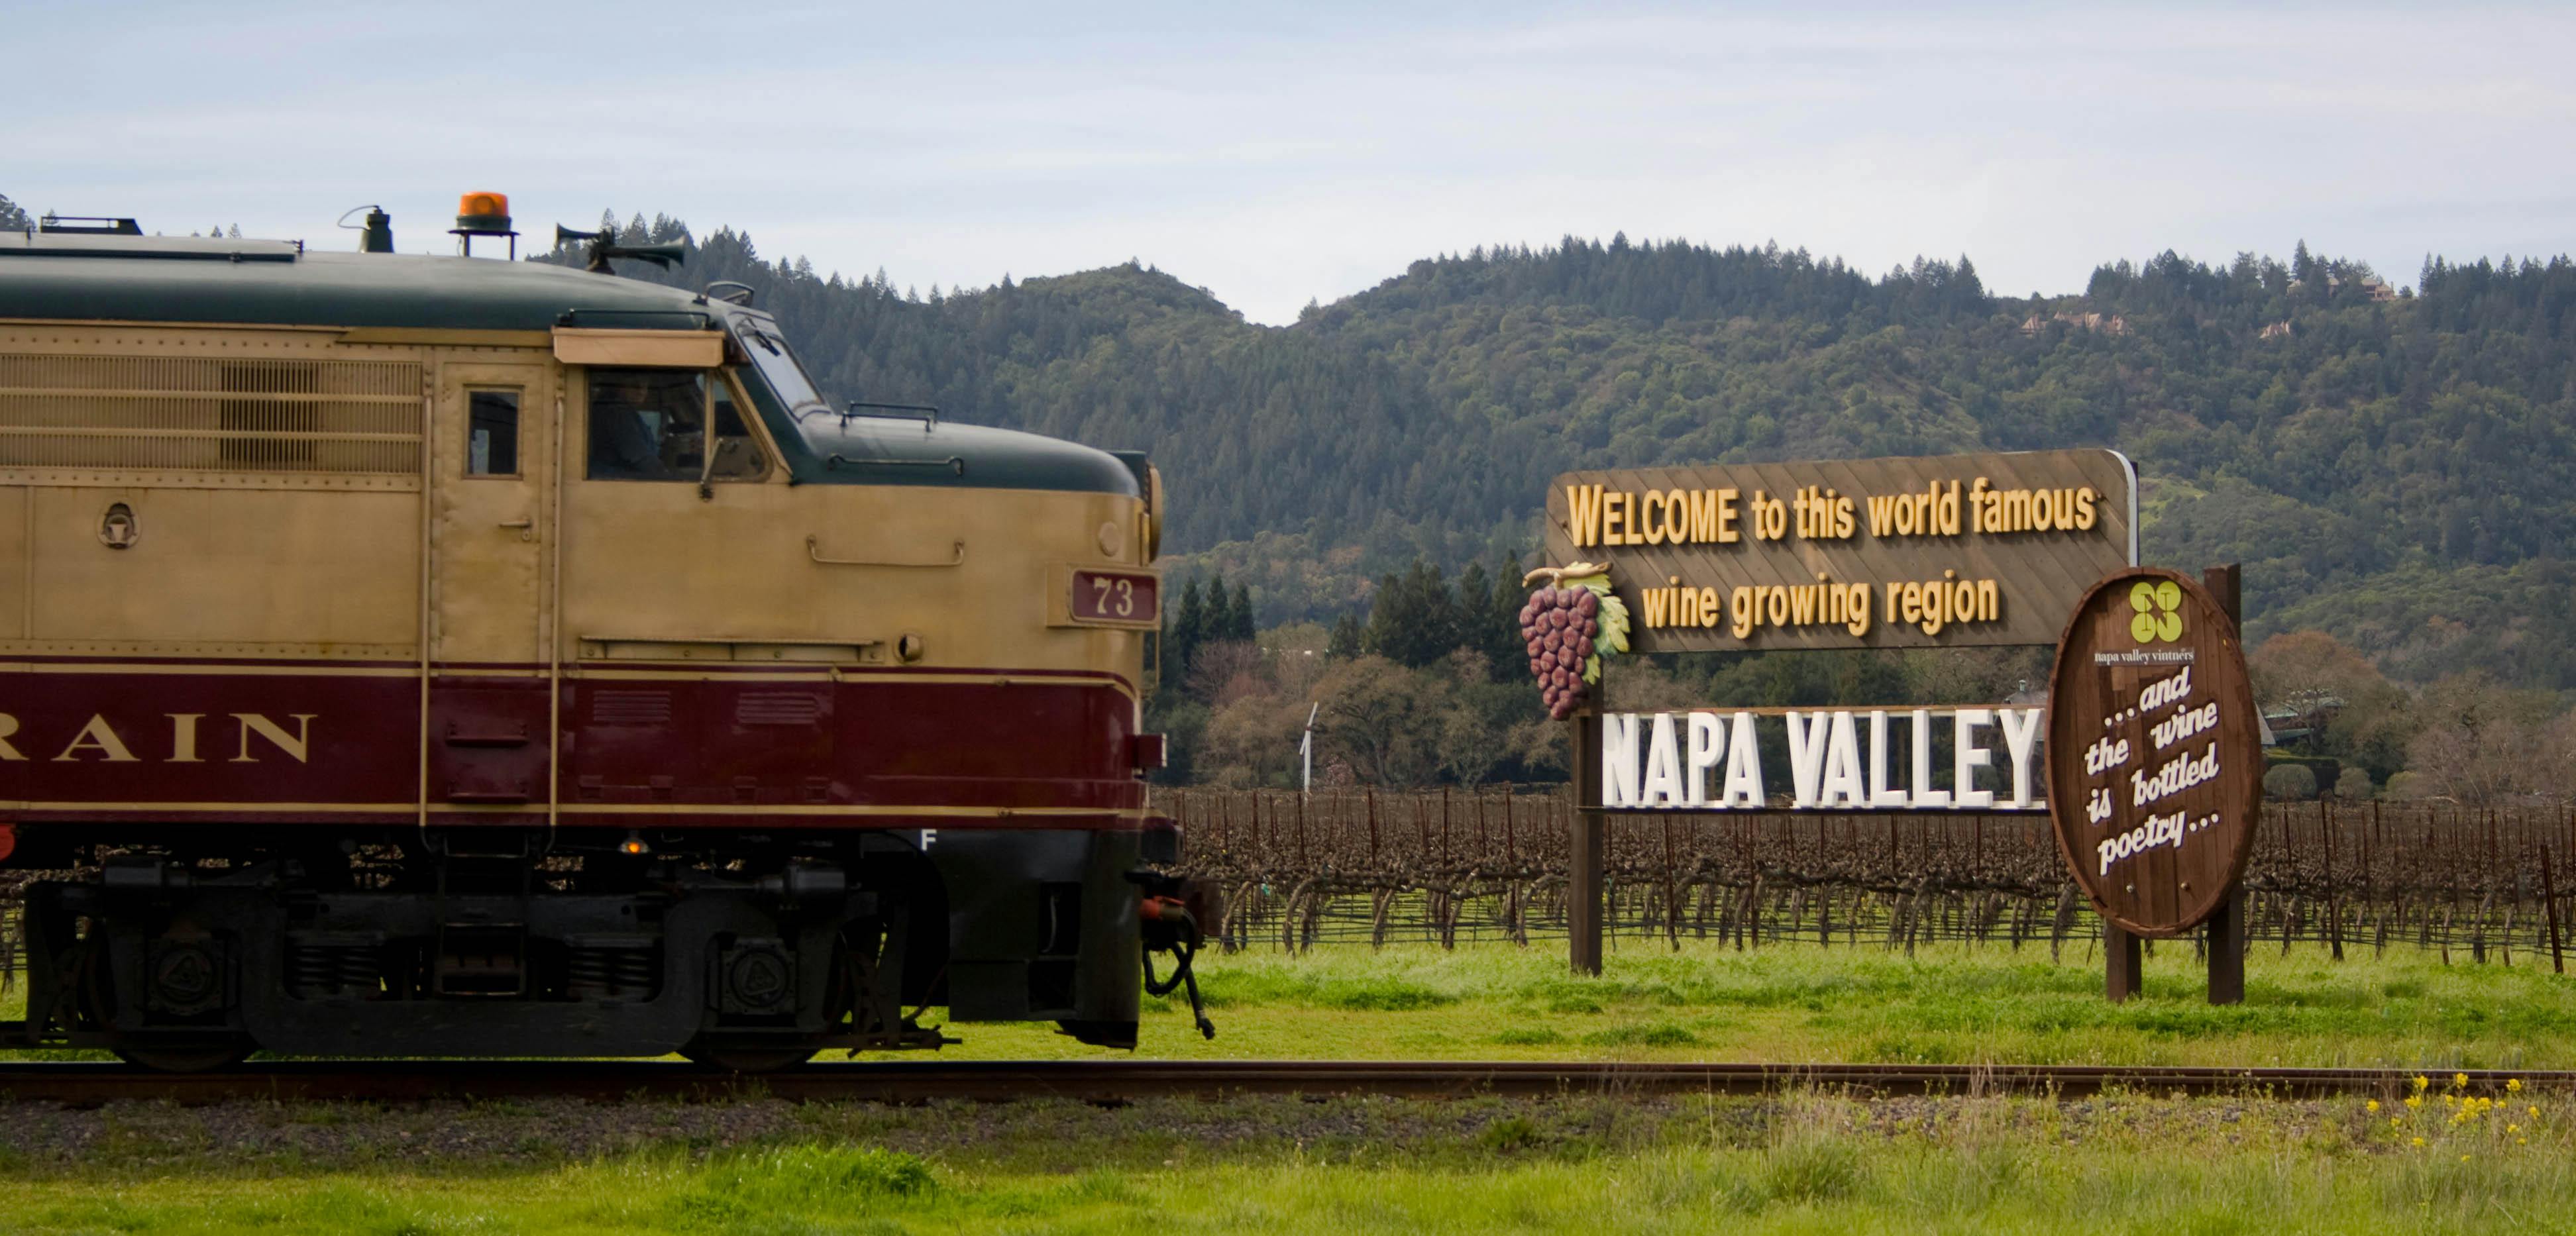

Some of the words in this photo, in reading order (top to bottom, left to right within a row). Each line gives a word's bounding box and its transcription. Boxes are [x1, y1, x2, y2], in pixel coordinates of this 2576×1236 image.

[1567, 484, 1739, 547] WELCOME
[1751, 489, 1787, 541] to
[1793, 485, 1855, 539] this
[1867, 479, 1961, 537] world
[1969, 477, 2096, 533] famous
[1094, 577, 1134, 616] 73
[1642, 576, 1720, 629] wine
[1731, 572, 1871, 639] growing
[1887, 569, 2000, 636] region
[2094, 652, 2120, 666] napa
[2120, 649, 2150, 665] valley
[2151, 649, 2194, 662] vintners
[1602, 711, 1765, 807] NAPA
[1786, 708, 2045, 808] VALLEY
[2084, 737, 2130, 776] the
[2149, 701, 2218, 749] wine
[2086, 787, 2112, 823] is
[2131, 742, 2220, 806] bottled
[922, 829, 937, 850] F
